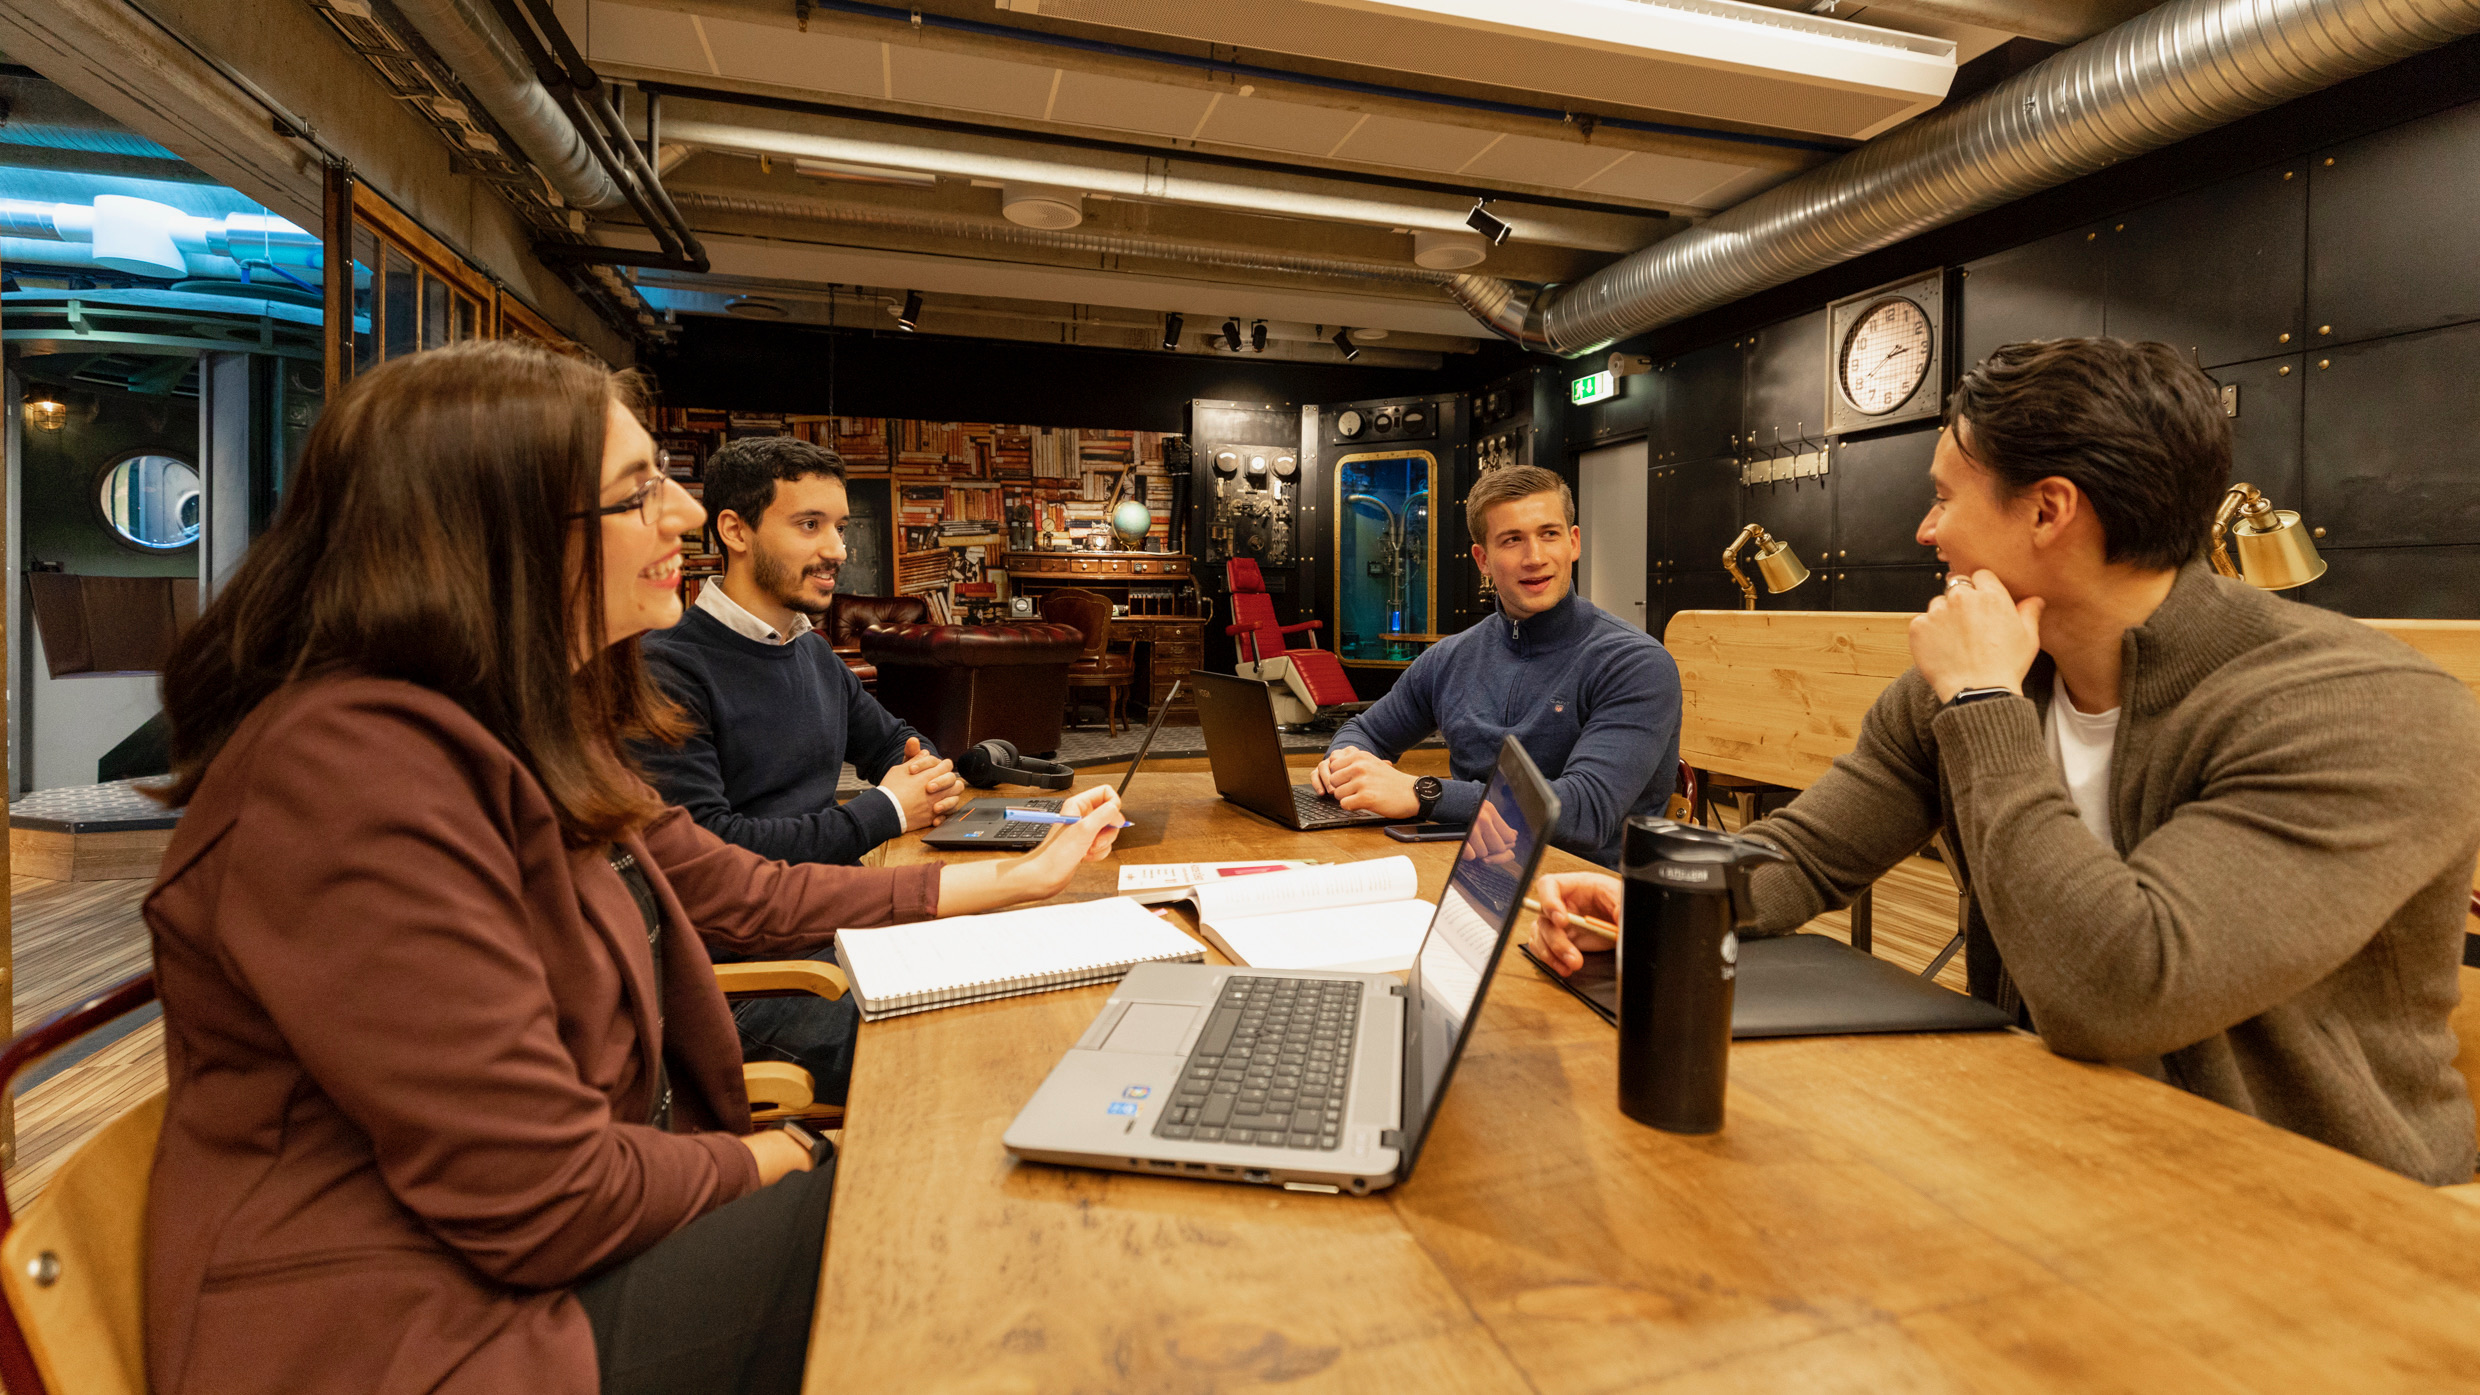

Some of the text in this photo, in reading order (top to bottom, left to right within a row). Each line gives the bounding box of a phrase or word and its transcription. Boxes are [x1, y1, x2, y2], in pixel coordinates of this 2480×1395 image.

[1885, 307, 1895, 322] 12
[1904, 310, 1909, 322] 1
[1869, 319, 1877, 333] 11
[1915, 321, 1923, 335] 2
[1856, 337, 1867, 351] 10
[1920, 340, 1928, 354] 3
[1851, 359, 1859, 372] 9
[1915, 363, 1923, 375] 4
[1855, 378, 1863, 391] 8
[1902, 381, 1910, 394] 5
[1868, 389, 1876, 402] 7
[1884, 391, 1892, 404] 6
